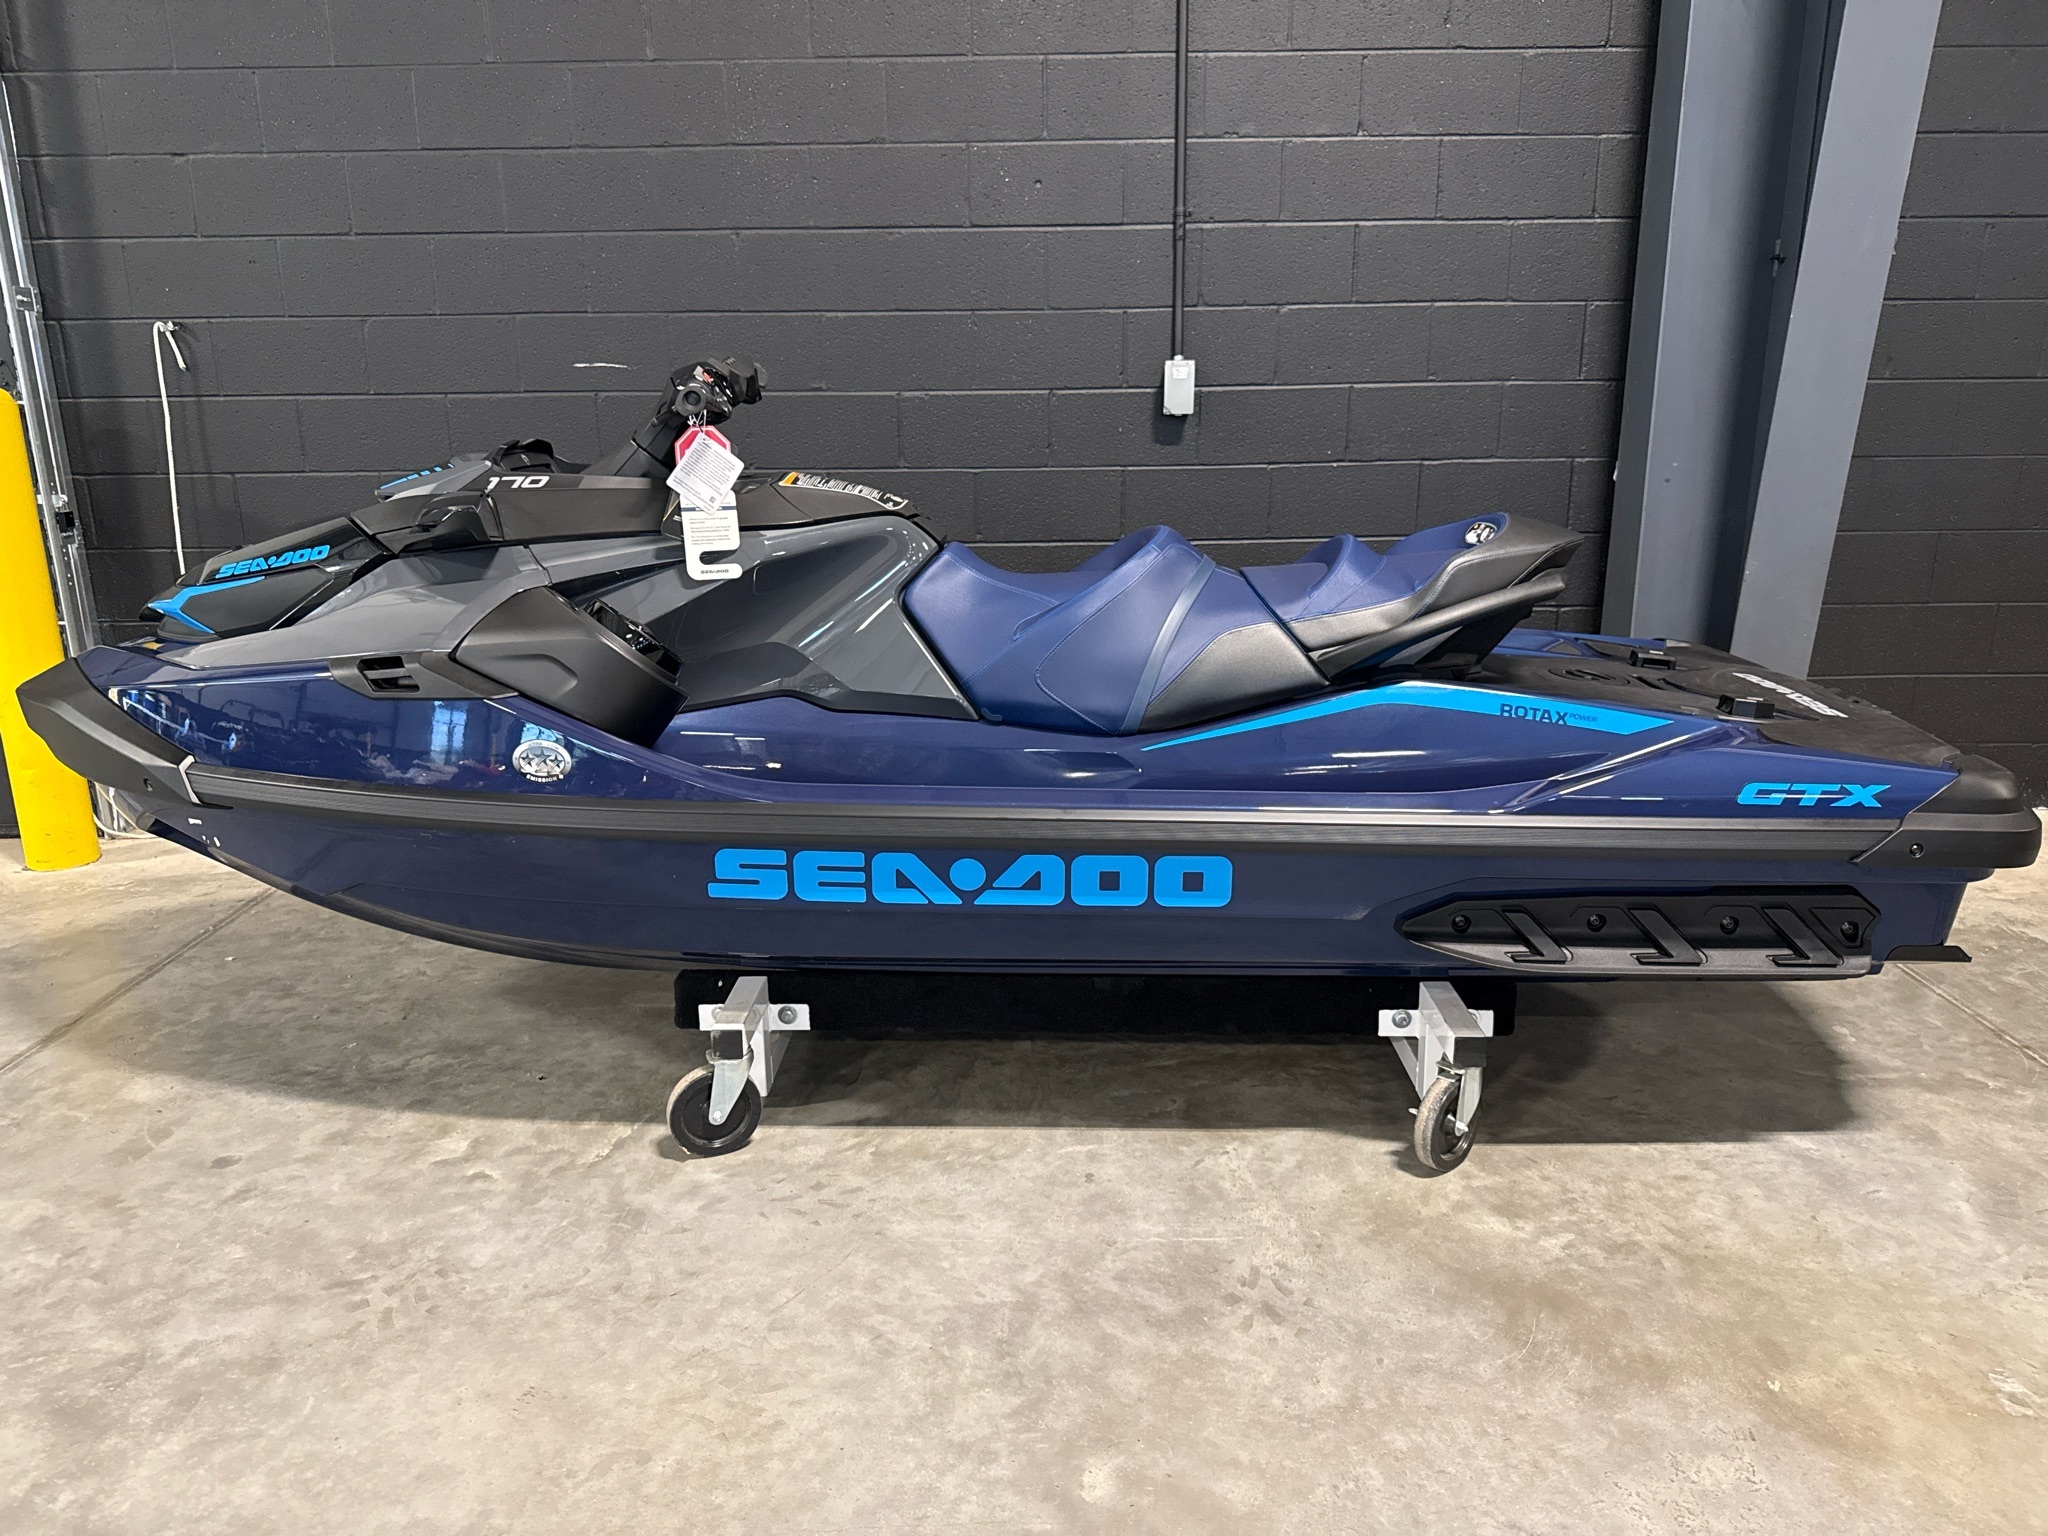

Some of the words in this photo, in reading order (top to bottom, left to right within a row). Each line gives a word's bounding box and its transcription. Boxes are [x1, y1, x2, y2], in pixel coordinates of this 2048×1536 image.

[484, 475, 550, 493] 170
[1499, 702, 1569, 725] ROTAX
[1569, 712, 1598, 723] POWER
[1736, 782, 1892, 808] GTX
